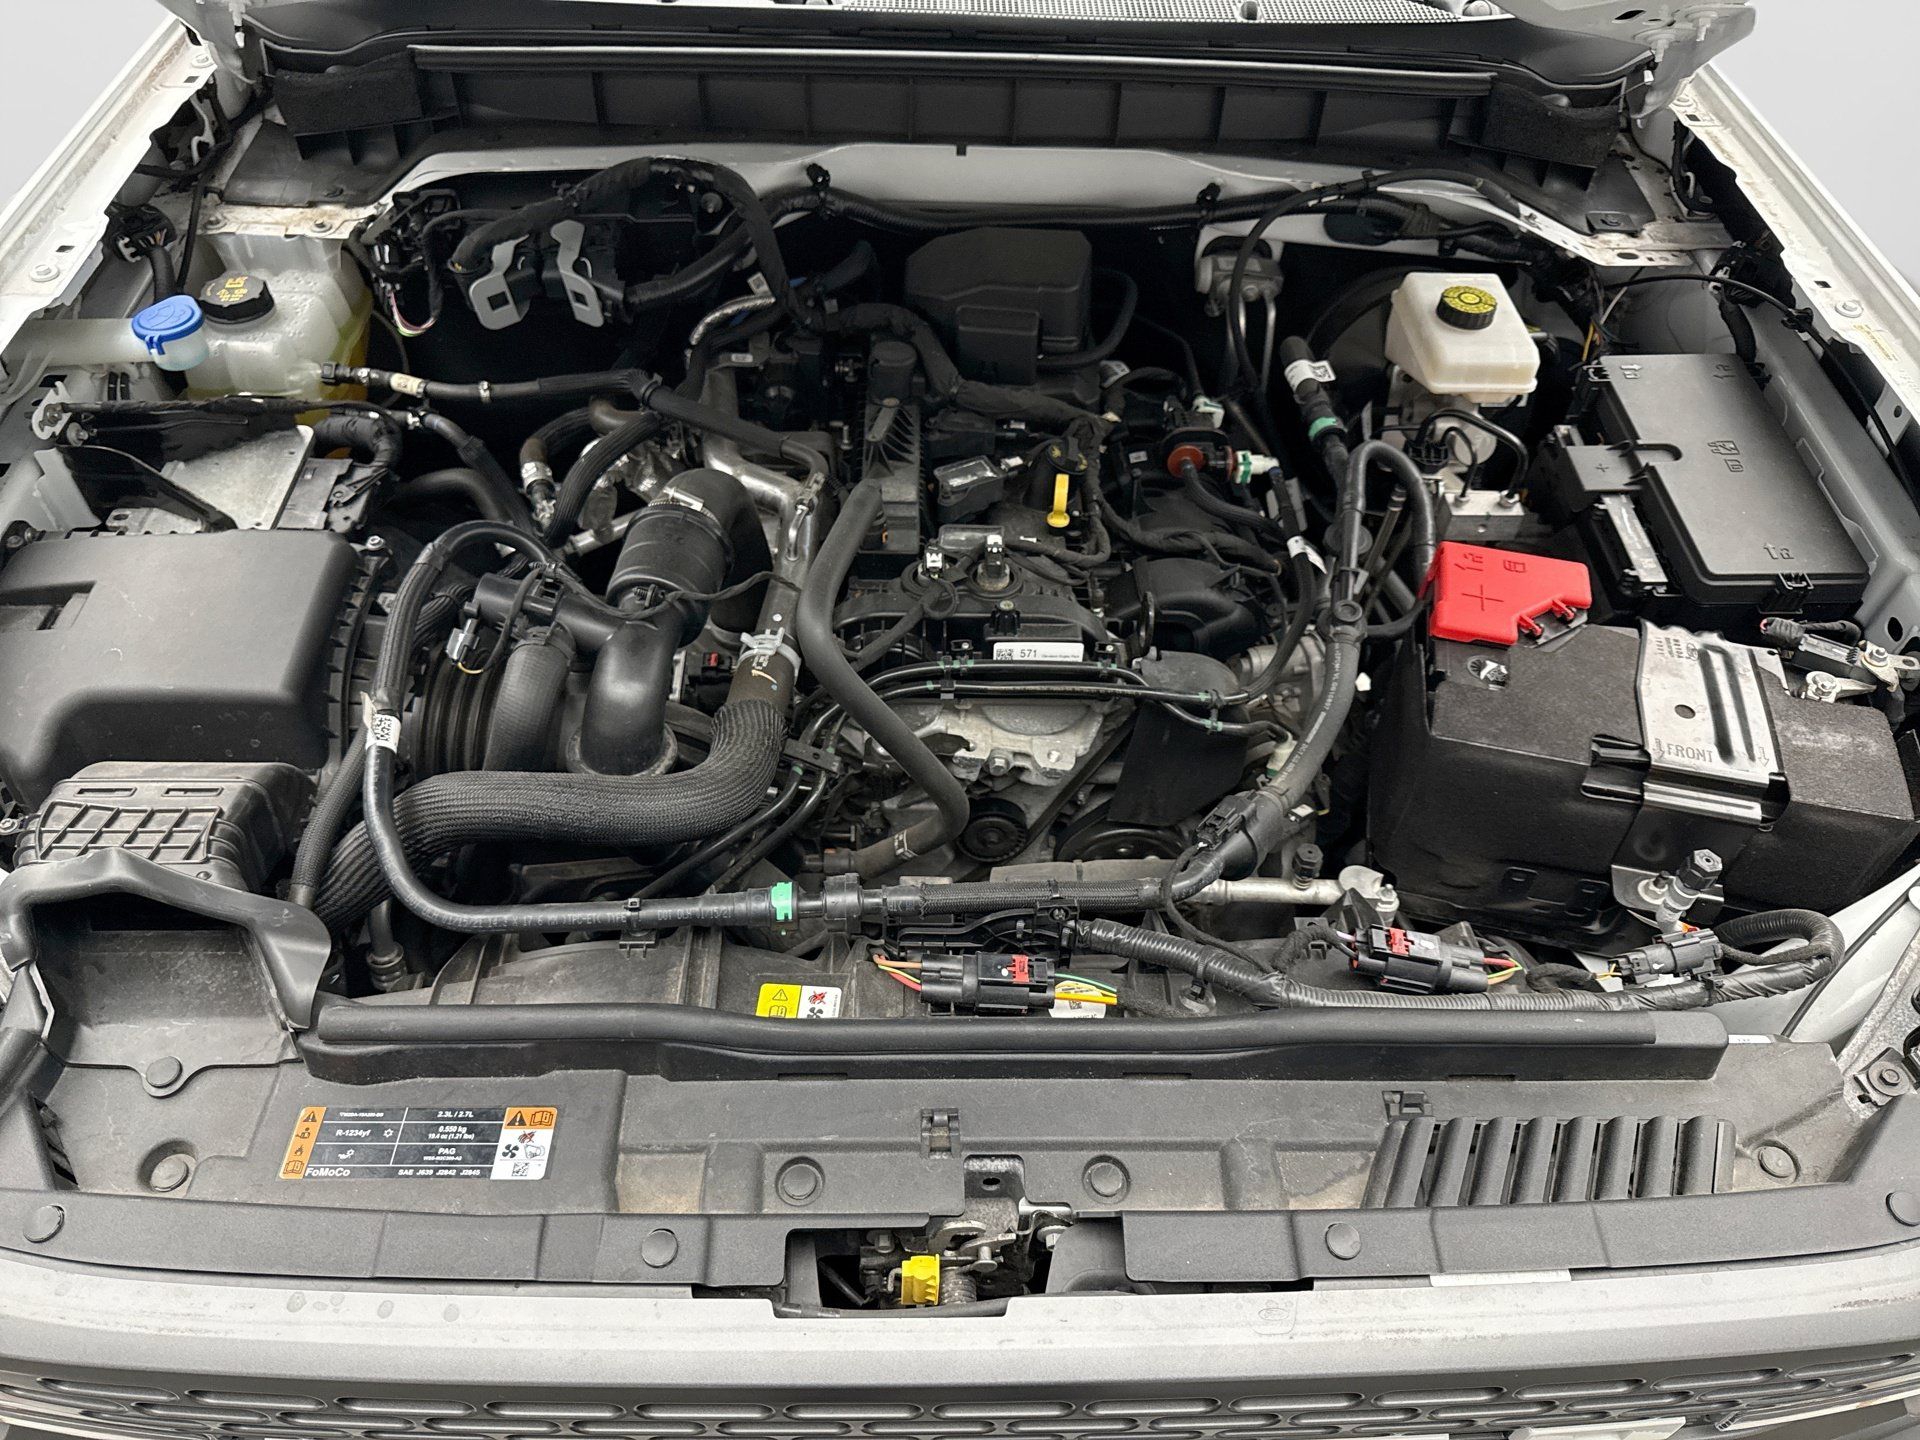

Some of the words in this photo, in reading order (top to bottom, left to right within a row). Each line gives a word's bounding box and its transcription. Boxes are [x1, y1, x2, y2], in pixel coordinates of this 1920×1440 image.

[1020, 649, 1037, 658] 571
[1666, 743, 1714, 763] FRONT
[336, 1129, 372, 1138] R-1234yf
[458, 1126, 467, 1134] kg
[304, 1167, 351, 1177] FoMoCo
